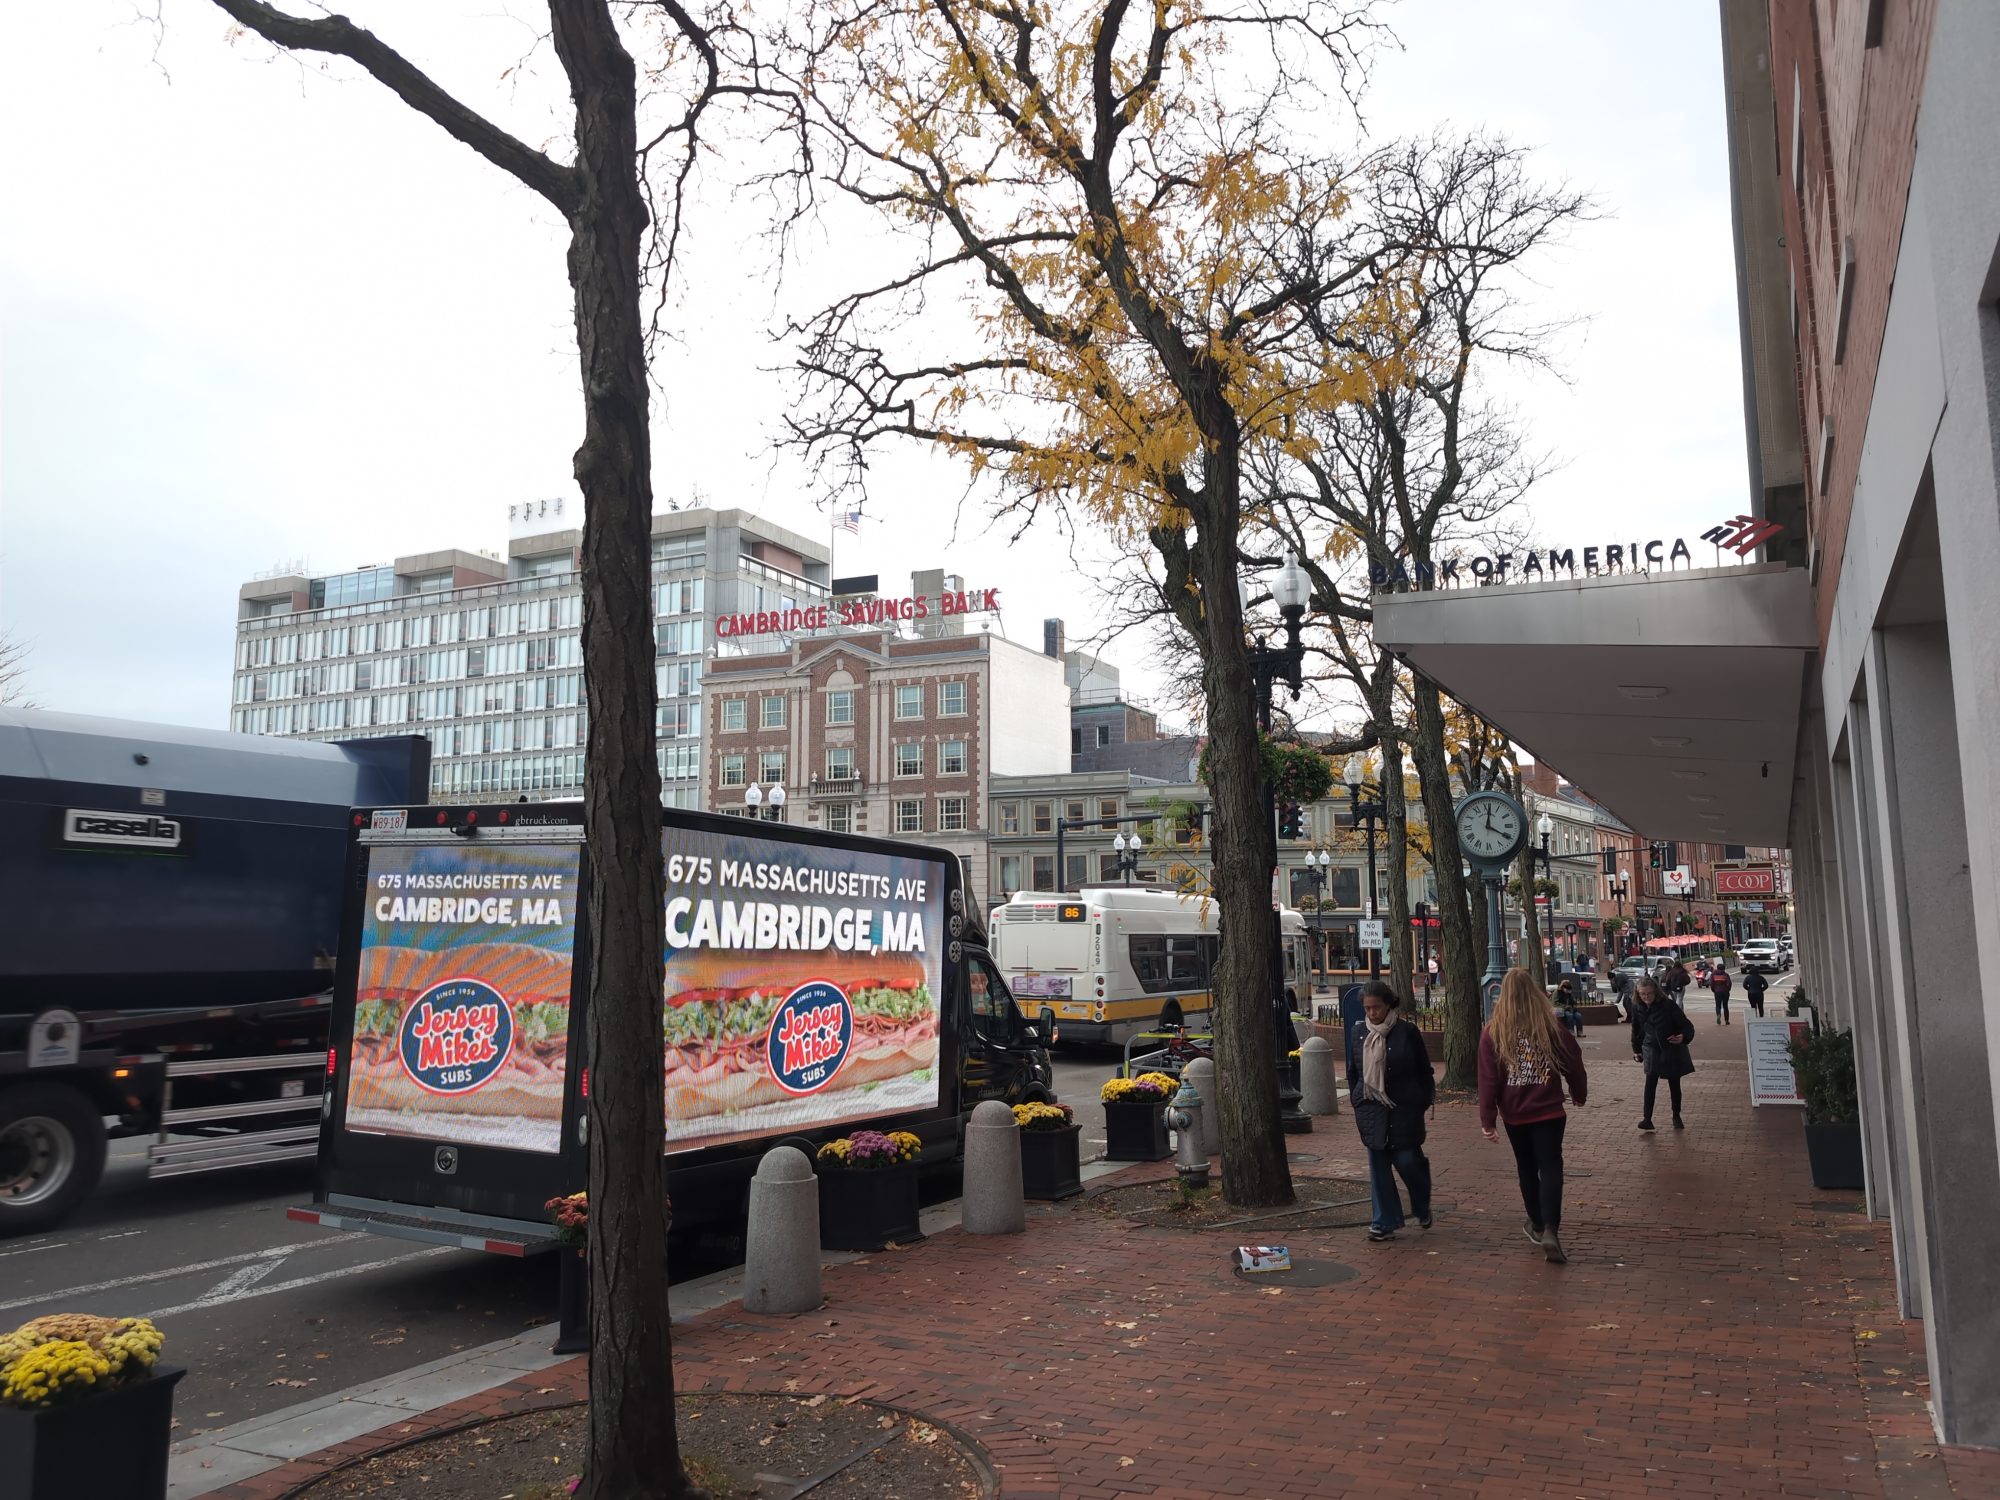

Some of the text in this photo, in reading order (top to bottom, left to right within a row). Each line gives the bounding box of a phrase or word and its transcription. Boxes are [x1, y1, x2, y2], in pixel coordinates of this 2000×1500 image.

[1370, 538, 1691, 585] BANK OF AMERICA
[715, 588, 999, 637] CAMBRIDGE SAVINGS BANK
[378, 874, 562, 890] 675 MASSACHUSETTS AVE
[667, 854, 926, 902] 675 MASSACHUSETTS AVE
[1726, 875, 1769, 889] COOP
[375, 897, 563, 927] CAMBRIDGE, MA
[665, 896, 926, 956] CAMBRIDGE, MA
[1064, 907, 1080, 918] 86
[436, 988, 476, 1000] SINCE 1956
[412, 1002, 499, 1038] Jersey
[778, 1002, 843, 1043] Jersey
[417, 1030, 498, 1071] Mike's
[783, 1028, 843, 1075] Mike's
[440, 1069, 472, 1085] SUBS
[801, 1065, 826, 1085] SUBS
